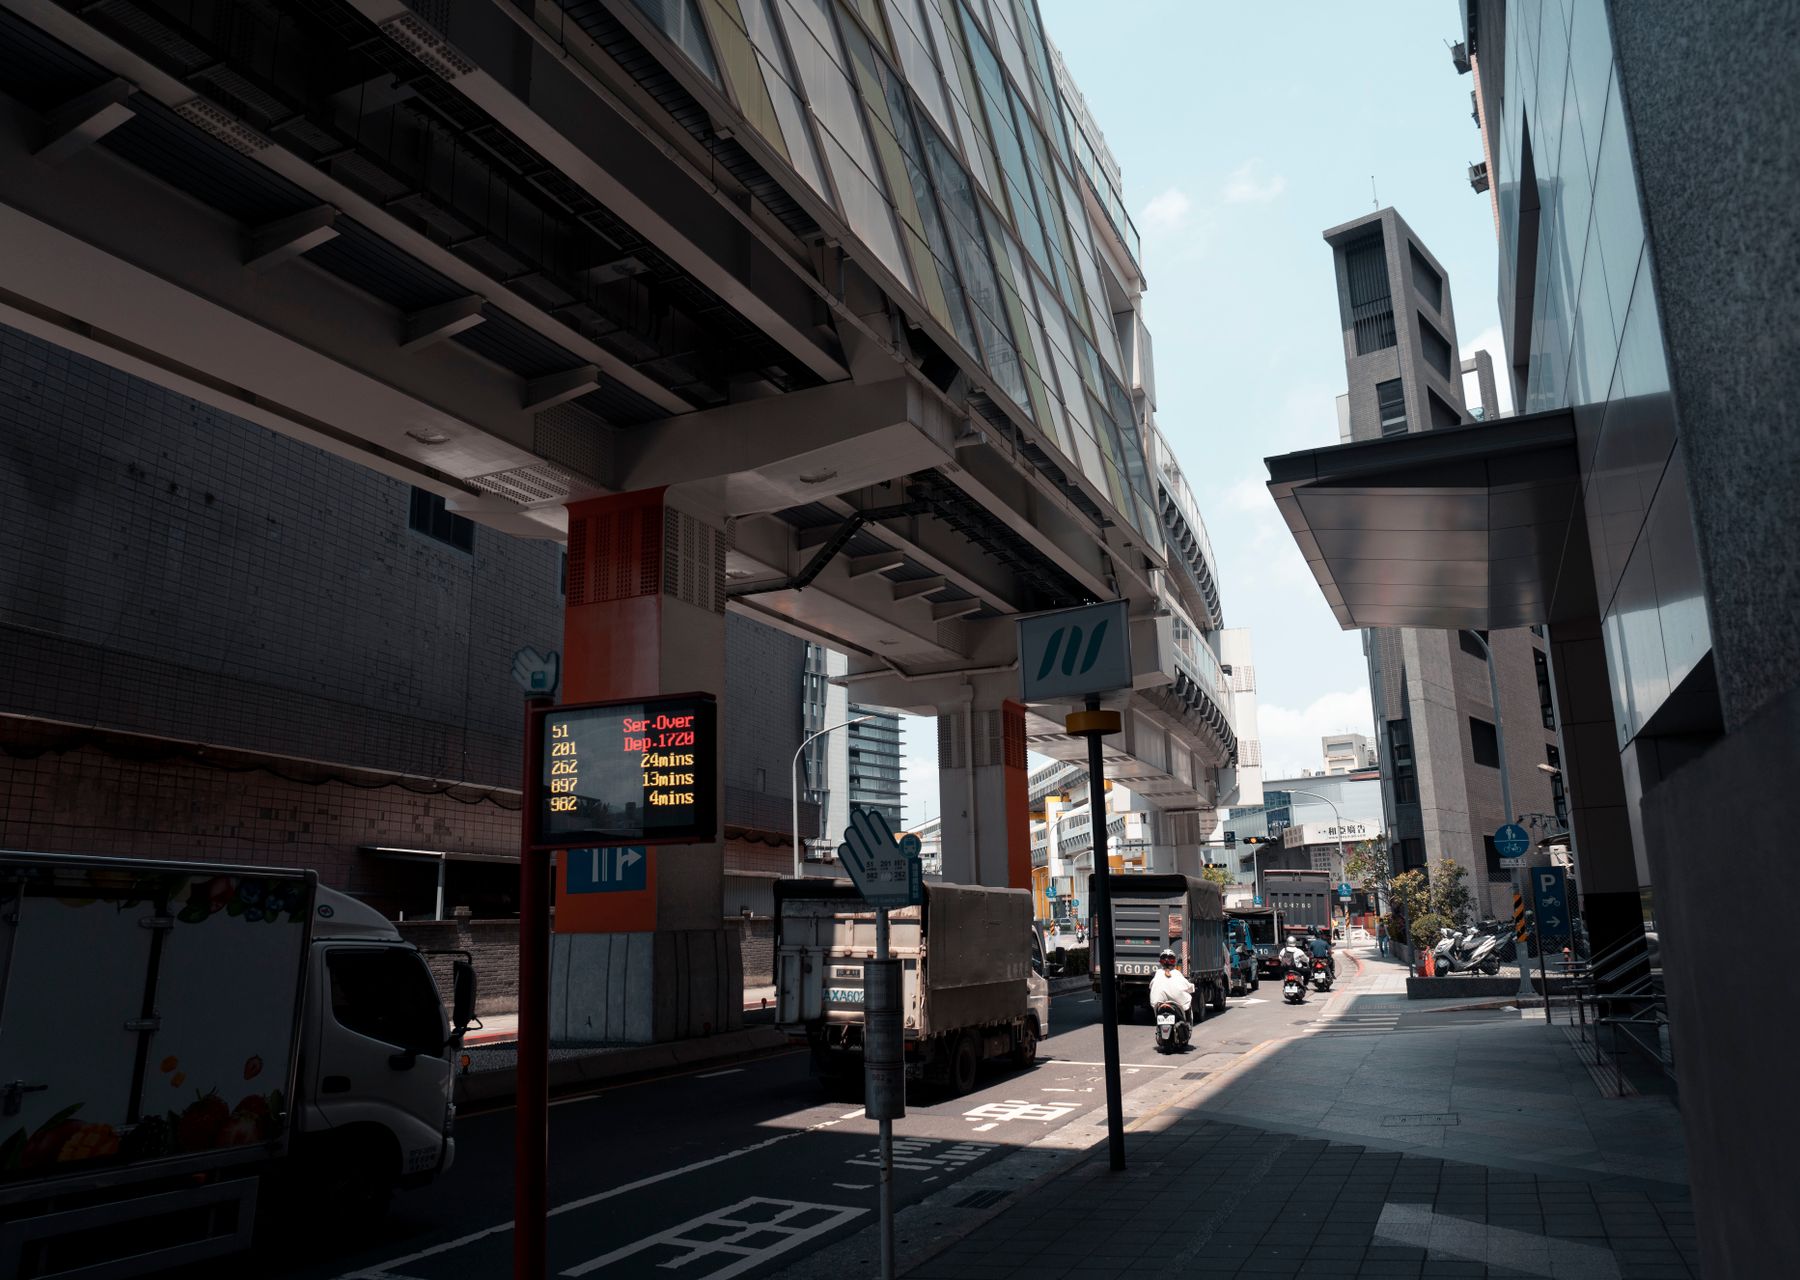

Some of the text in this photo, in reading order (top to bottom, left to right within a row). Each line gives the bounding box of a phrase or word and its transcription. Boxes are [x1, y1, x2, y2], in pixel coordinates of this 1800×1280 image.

[552, 724, 568, 738] 51
[623, 714, 694, 733] Ser.Over
[552, 741, 577, 756] 201
[624, 732, 694, 752] Dep.1720
[551, 759, 578, 775] 262
[640, 752, 694, 768] 24mins
[551, 777, 577, 793] 897
[642, 771, 694, 787] 13mins
[550, 795, 577, 812] 982
[648, 790, 694, 806] 4mins
[1225, 832, 1232, 842] P
[1540, 874, 1556, 893] P
